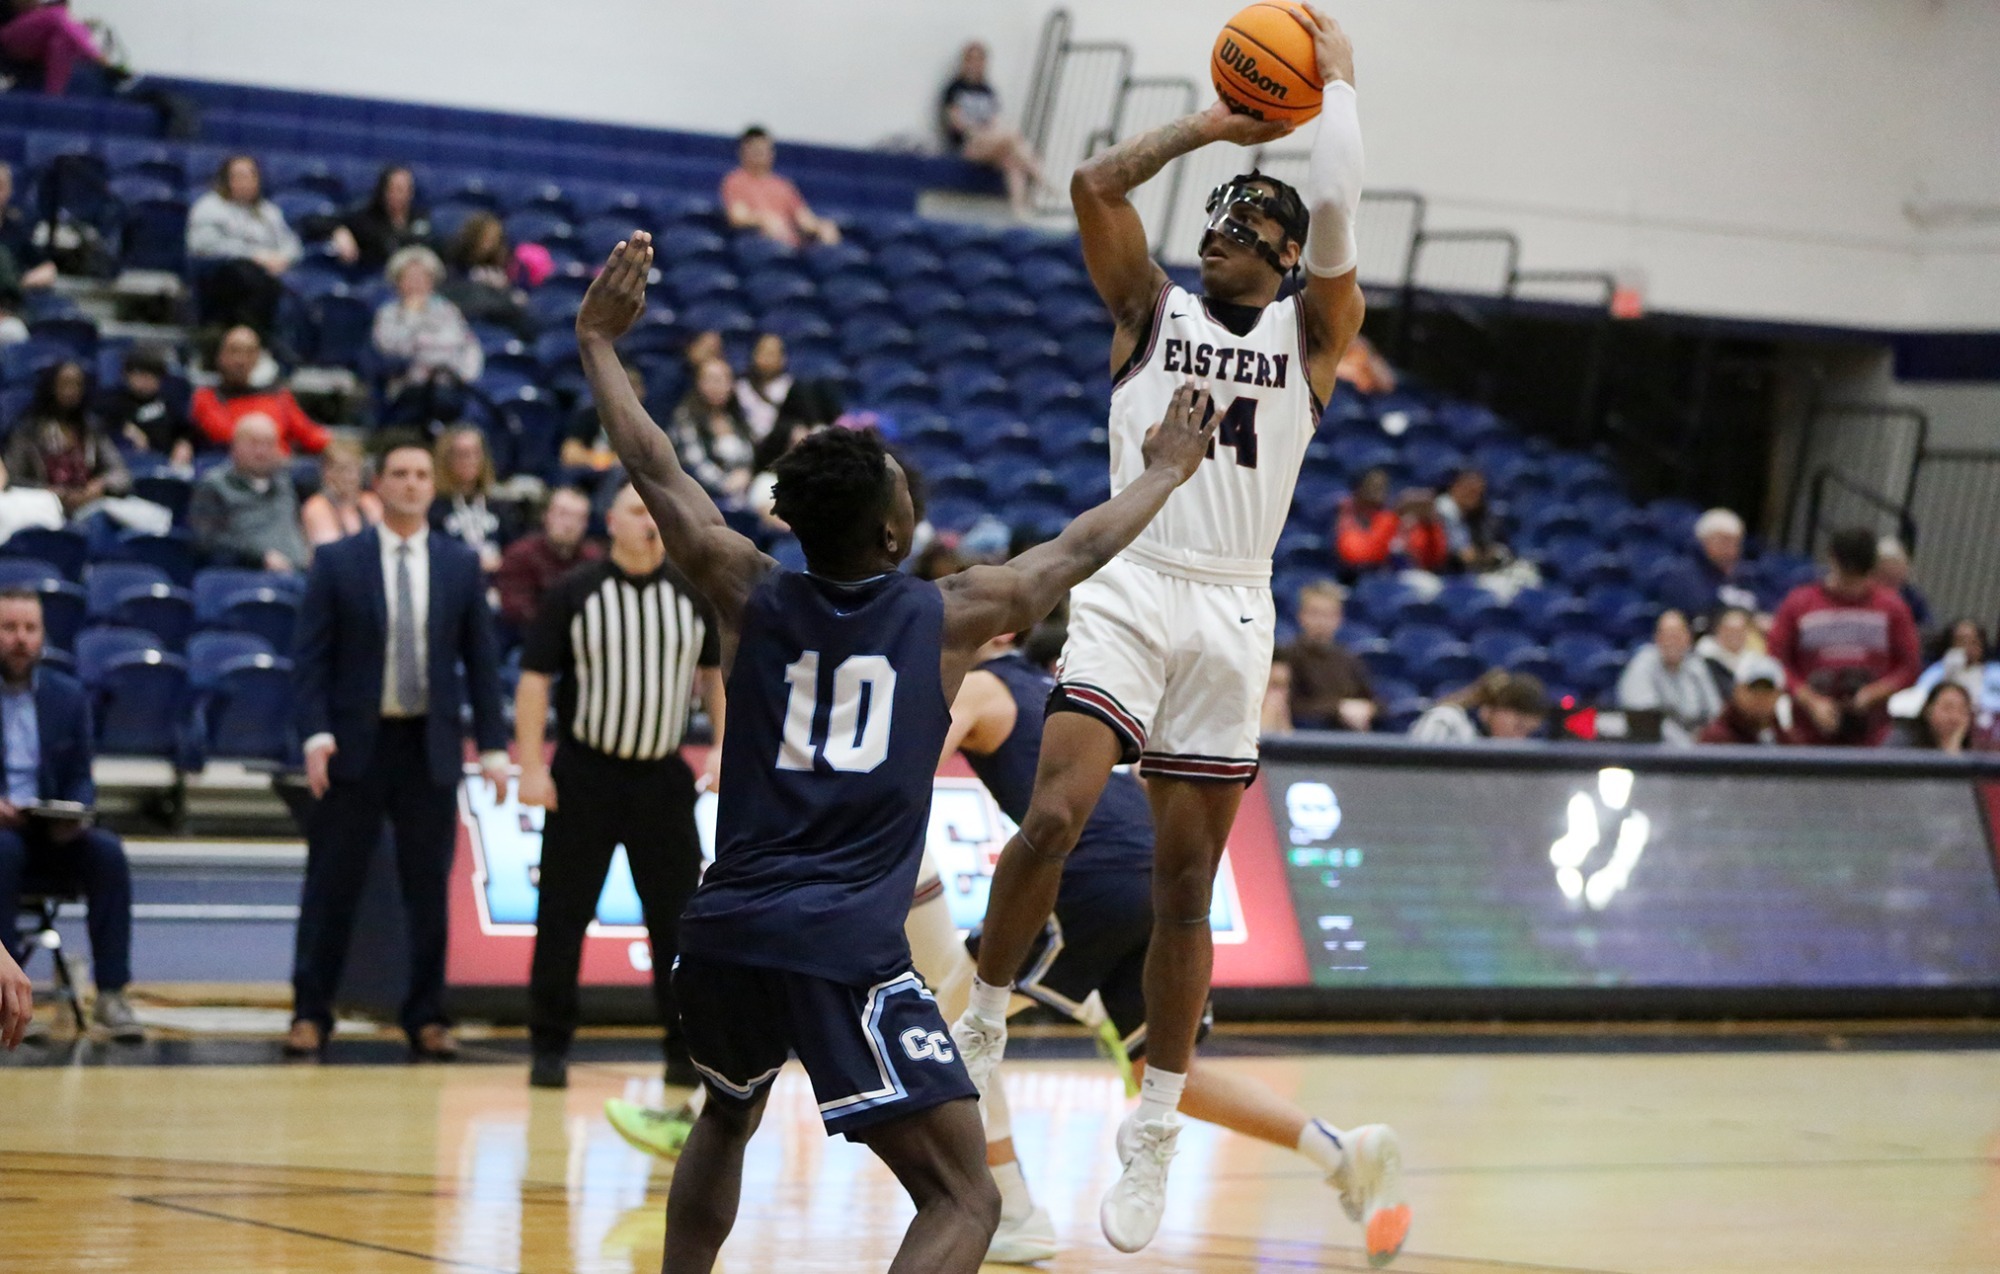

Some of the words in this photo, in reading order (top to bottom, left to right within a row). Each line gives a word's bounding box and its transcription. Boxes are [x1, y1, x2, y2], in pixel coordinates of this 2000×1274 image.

[1220, 38, 1288, 100] Wilson
[1164, 338, 1289, 389] EASTERN
[775, 649, 897, 774] 10
[899, 1026, 955, 1064] CC
